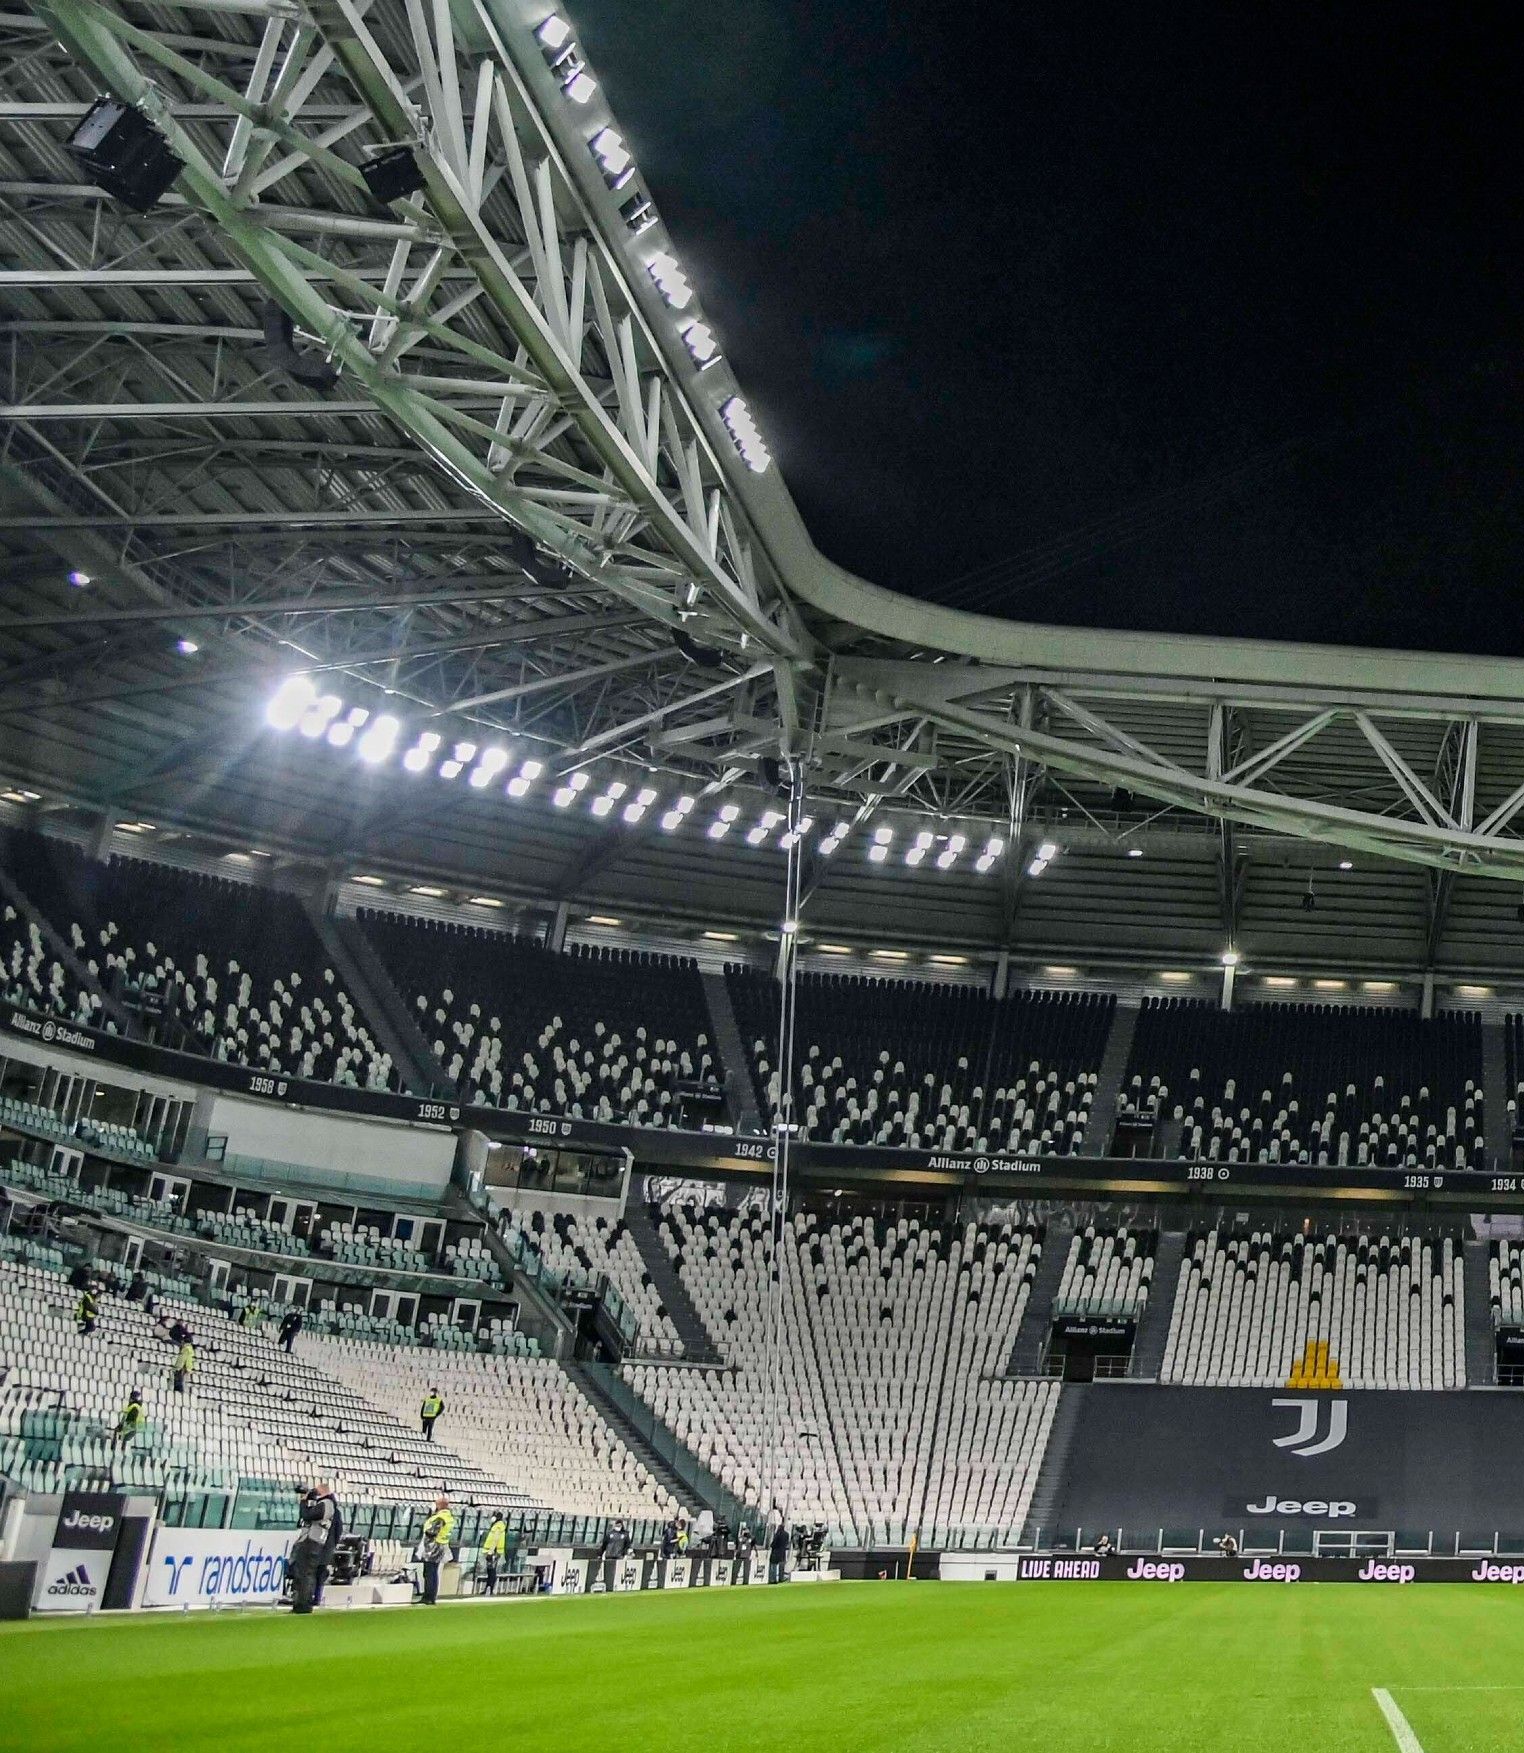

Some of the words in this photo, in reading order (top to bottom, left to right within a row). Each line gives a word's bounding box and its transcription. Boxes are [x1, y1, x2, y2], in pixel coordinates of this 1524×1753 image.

[11, 1012, 42, 1035] Allianz
[56, 1027, 95, 1050] Stadium
[250, 1076, 274, 1094] 1958
[418, 1104, 445, 1119] 1952
[529, 1119, 556, 1134] 1950
[735, 1143, 763, 1158] 1942
[928, 1157, 971, 1170] Allianz
[992, 1160, 1041, 1172] Stadium
[1187, 1167, 1214, 1179] 1938
[1404, 1176, 1429, 1188] 1935
[1491, 1178, 1516, 1190] 1934
[1246, 1496, 1357, 1517] Jeep
[63, 1509, 114, 1532] Jeep
[199, 1540, 289, 1594] randstad
[1021, 1560, 1051, 1578] LIVE
[1054, 1561, 1100, 1578] AHEAD
[1127, 1557, 1185, 1582] Jeep
[1244, 1559, 1301, 1583] Jeep
[1358, 1559, 1415, 1583] Jeep
[47, 1584, 97, 1596] adidas
